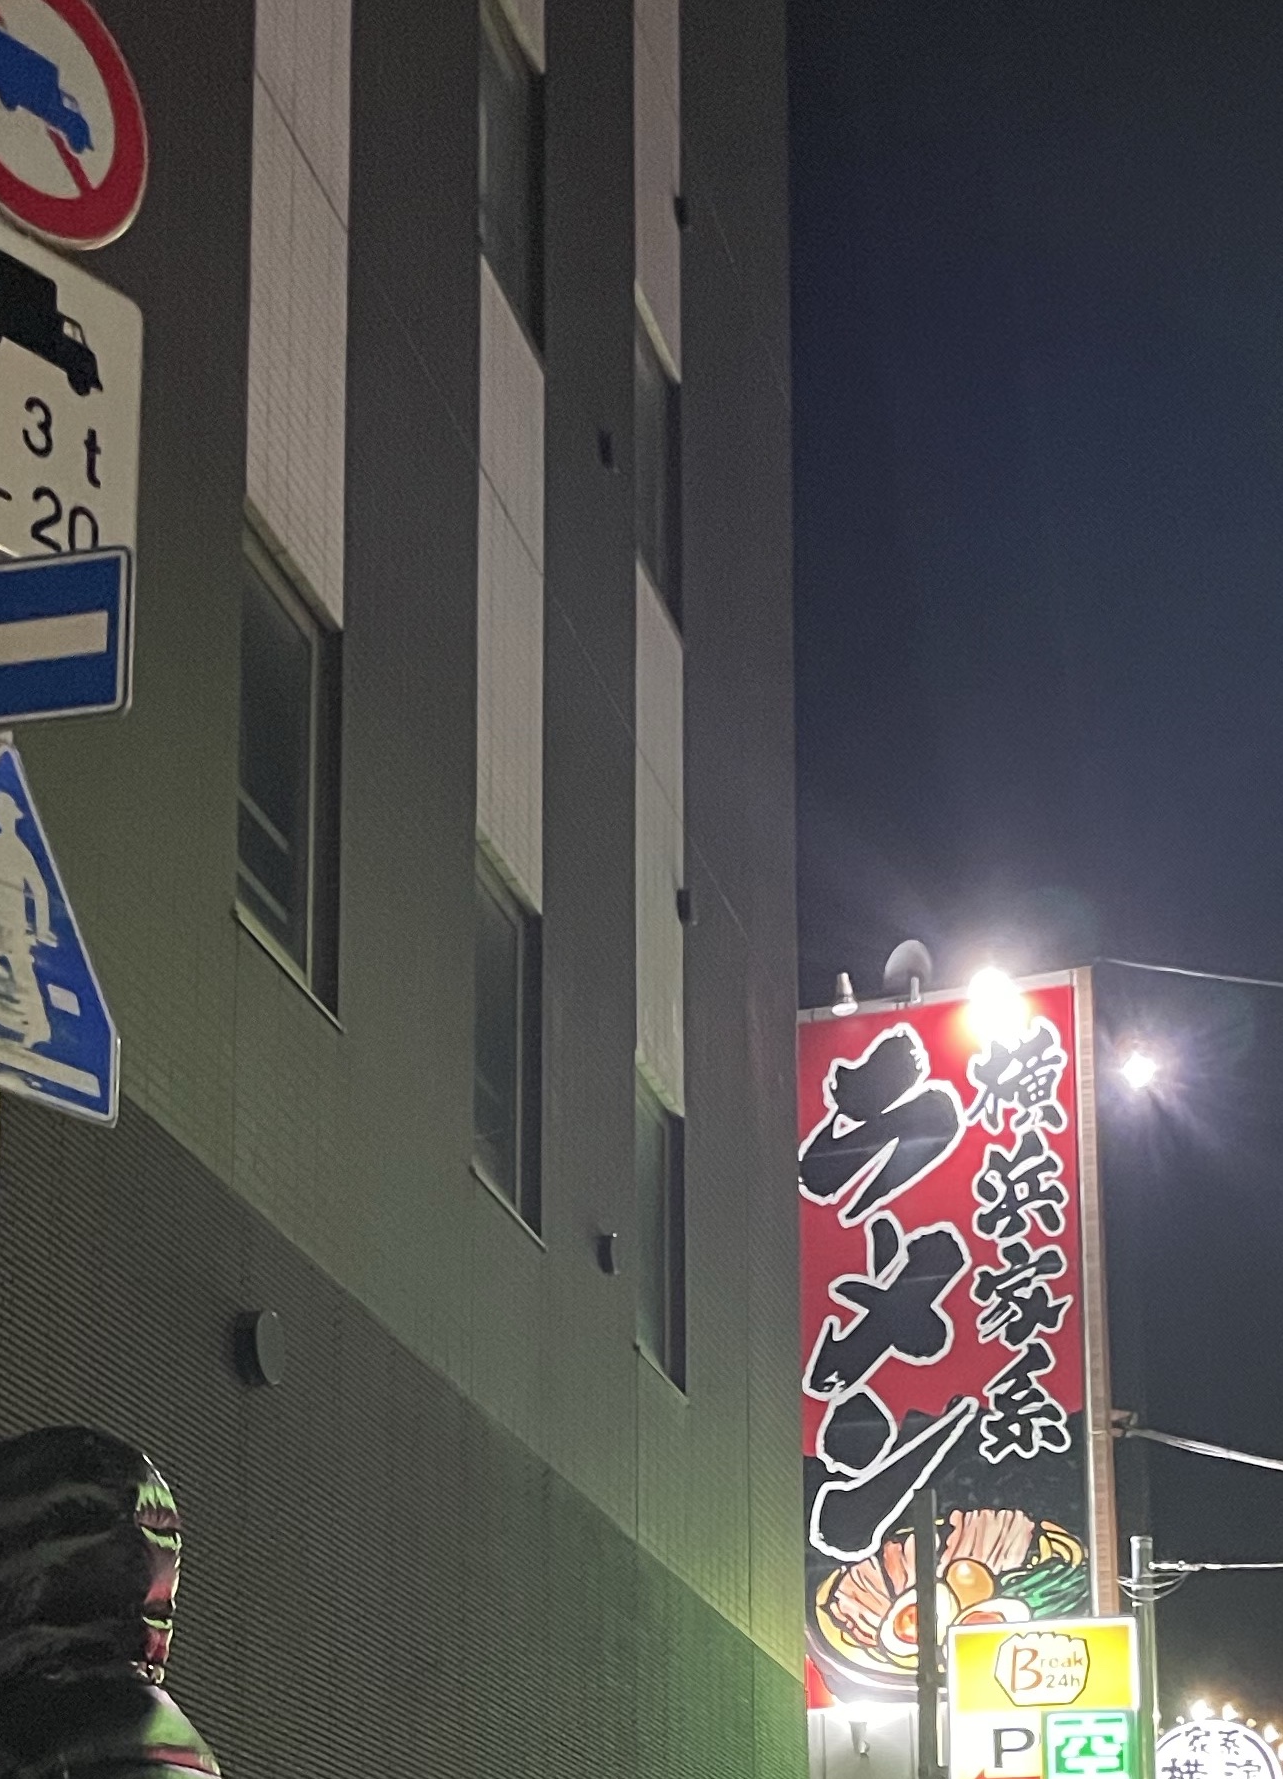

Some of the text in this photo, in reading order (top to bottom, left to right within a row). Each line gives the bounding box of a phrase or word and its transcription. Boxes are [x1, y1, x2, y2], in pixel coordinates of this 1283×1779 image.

[965, 1015, 1072, 1465] 横浜家系
[797, 1021, 979, 1563] ラーメン
[1010, 1645, 1084, 1694] Break
[1045, 1672, 1081, 1689] 24h
[992, 1727, 1036, 1769] P
